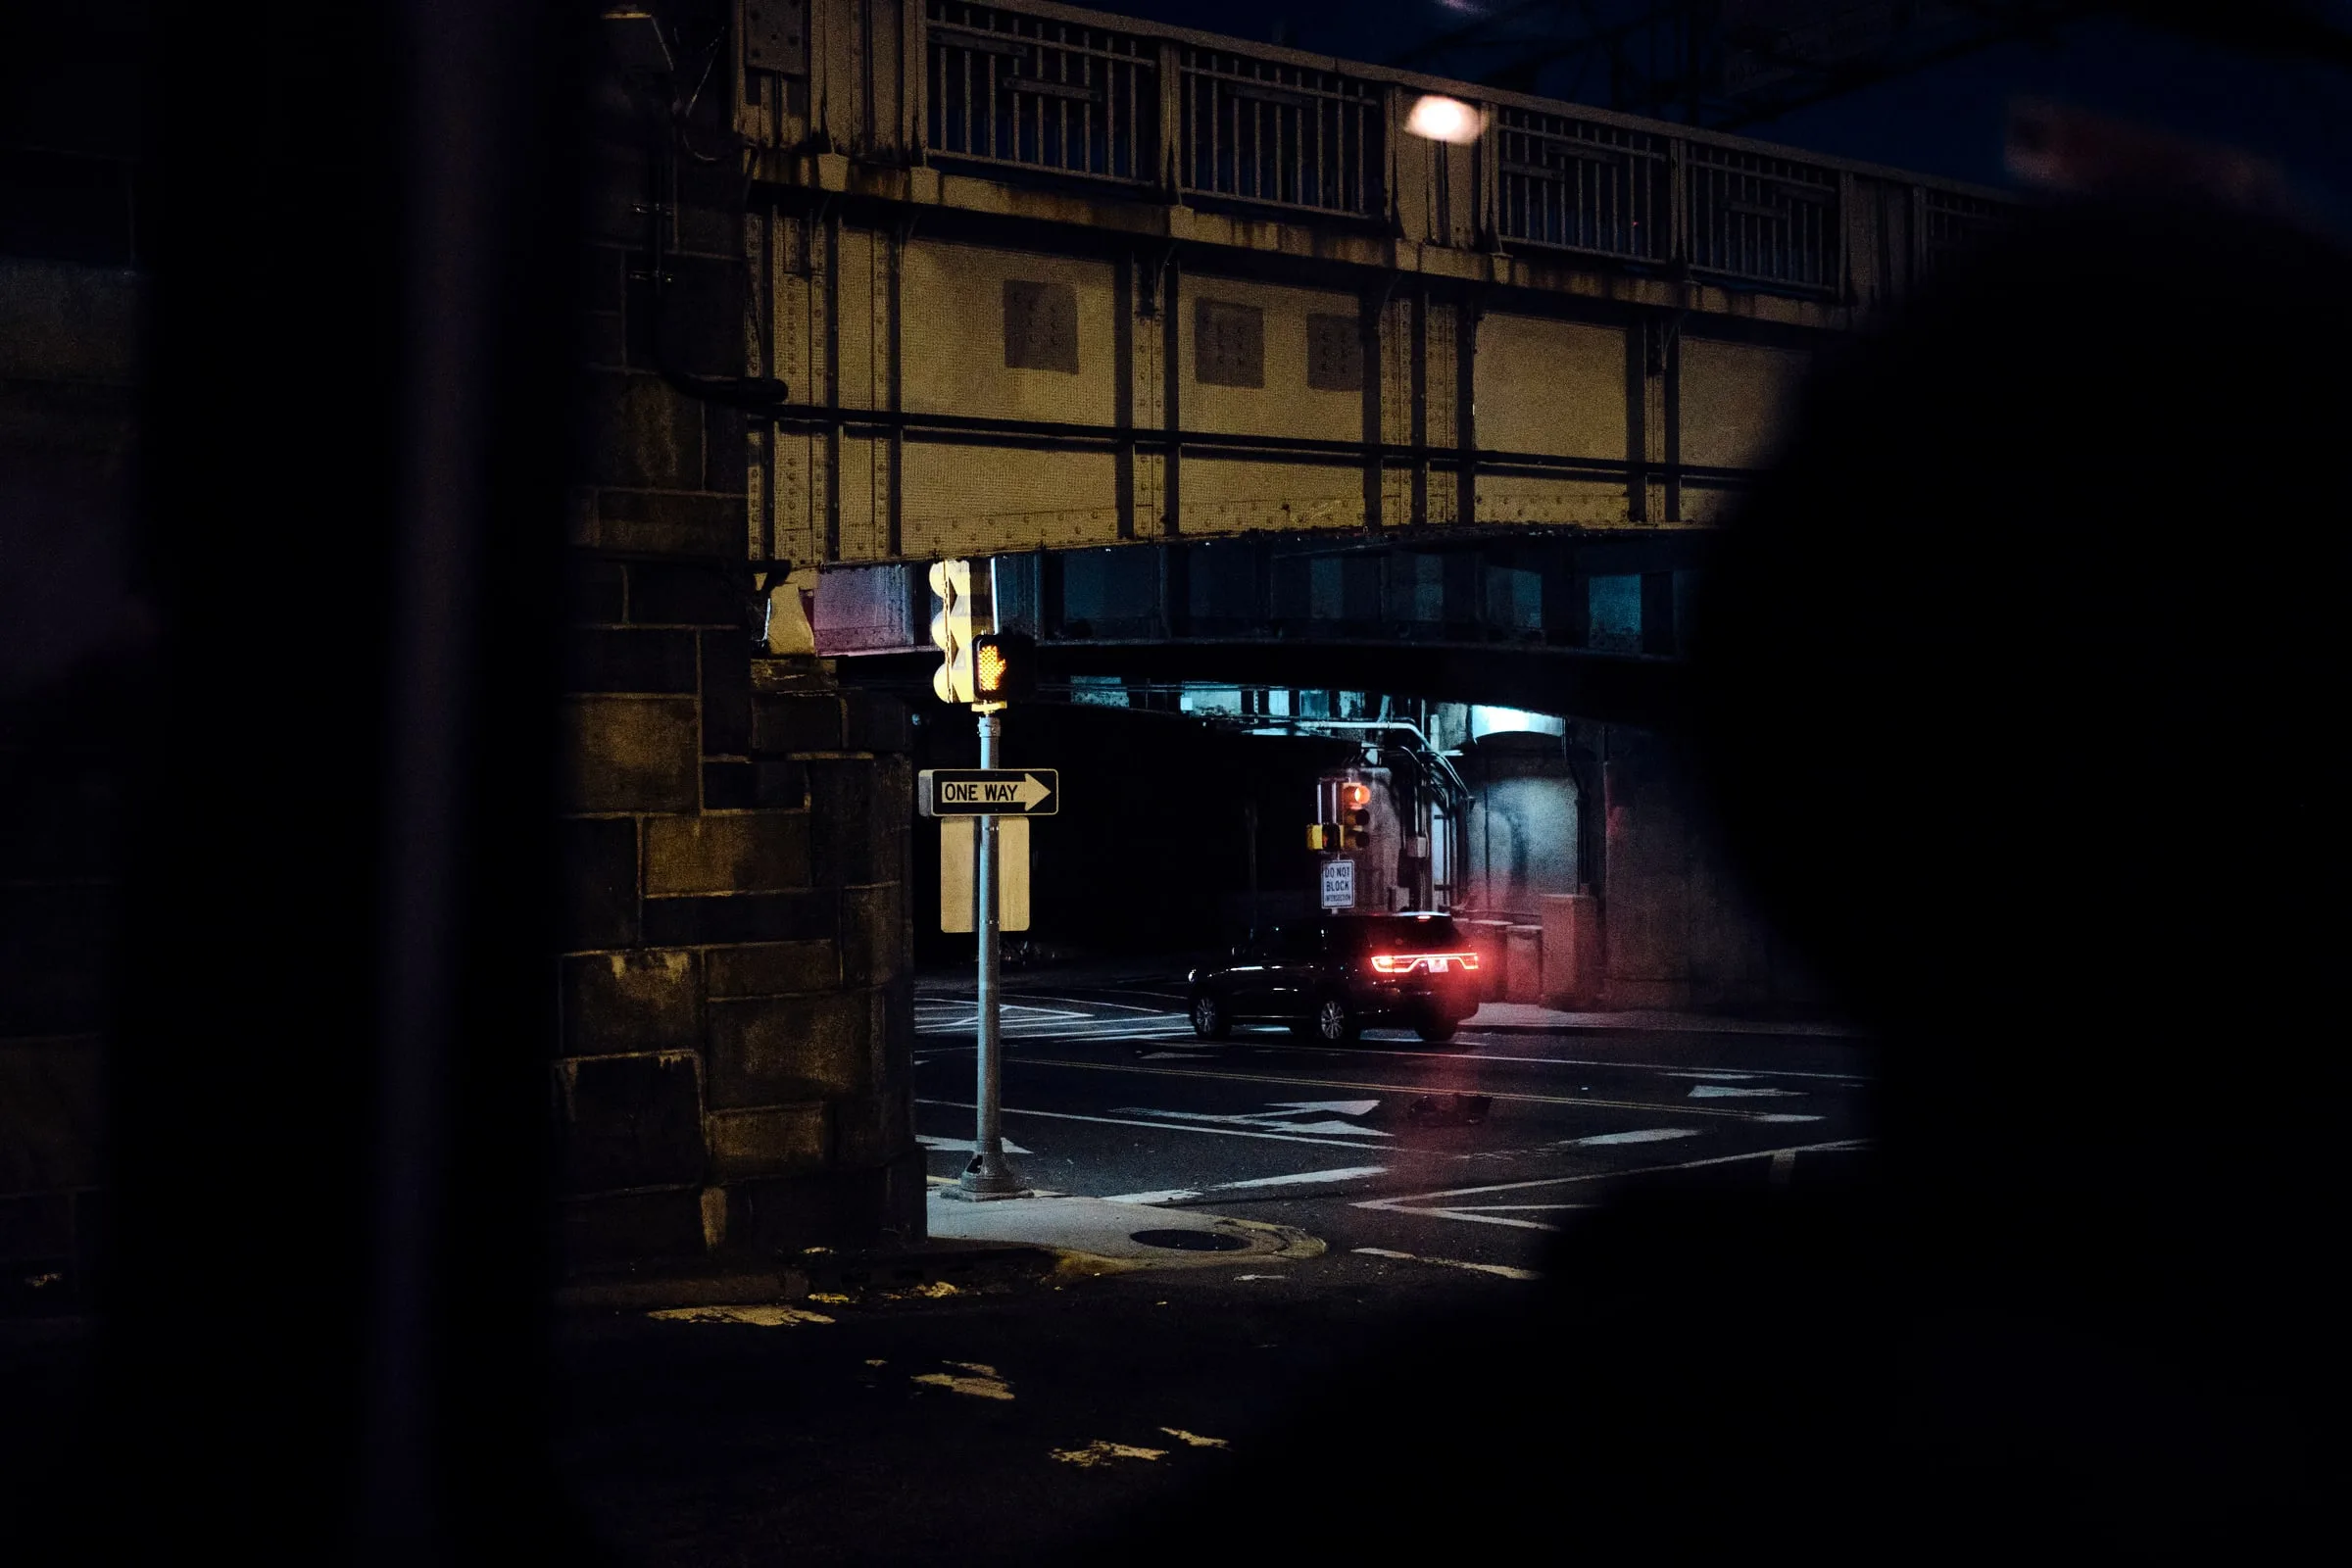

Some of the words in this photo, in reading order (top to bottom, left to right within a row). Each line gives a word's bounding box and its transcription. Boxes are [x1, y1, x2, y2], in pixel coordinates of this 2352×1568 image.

[945, 783, 978, 802] ONE
[984, 784, 1018, 802] WAY
[1325, 866, 1335, 878] DO
[1337, 866, 1349, 877] NOT
[1326, 880, 1349, 892] BLOCK
